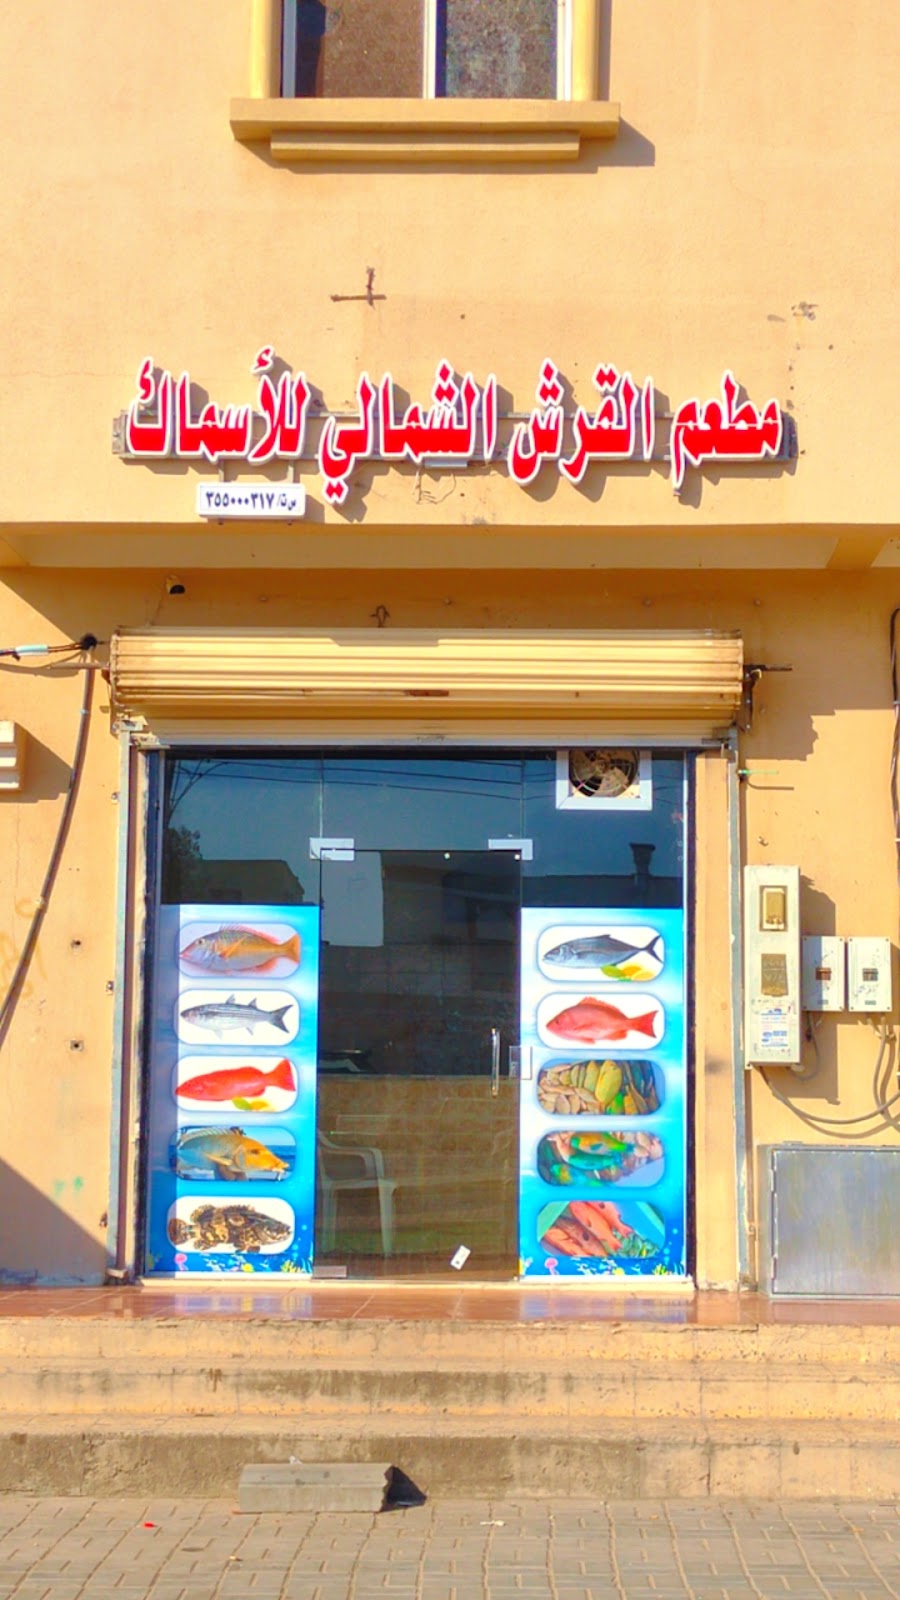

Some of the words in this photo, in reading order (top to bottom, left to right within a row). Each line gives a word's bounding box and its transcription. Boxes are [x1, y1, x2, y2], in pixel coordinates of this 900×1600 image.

[127, 346, 311, 463] للأسماك
[318, 359, 497, 503] الشمالي
[508, 359, 655, 483] القرش
[672, 371, 783, 488] مطعم
